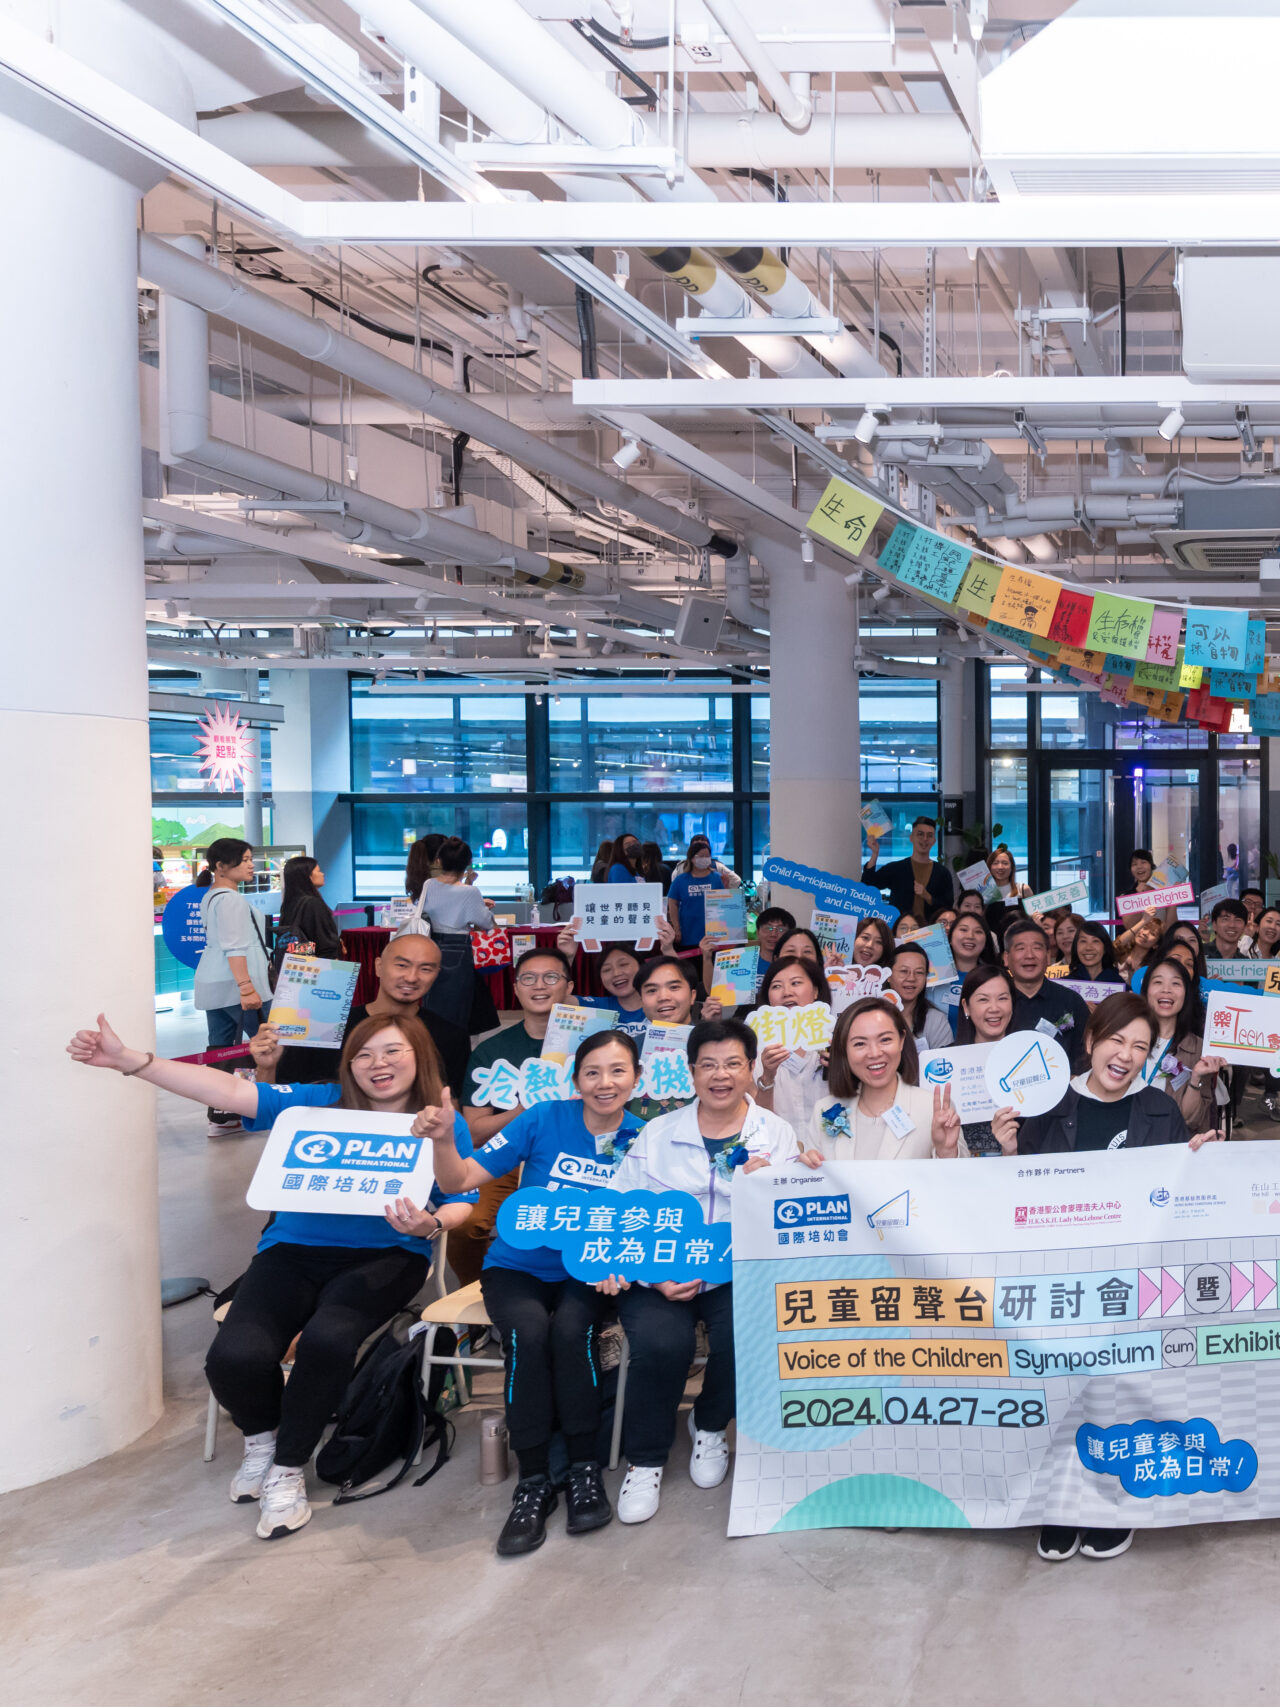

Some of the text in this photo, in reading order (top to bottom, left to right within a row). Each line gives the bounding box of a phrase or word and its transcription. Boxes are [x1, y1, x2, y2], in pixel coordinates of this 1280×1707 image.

[819, 492, 867, 542] 生命
[1191, 623, 1231, 641] 可以
[216, 745, 237, 759] 起點
[769, 863, 877, 906] Child Participation Today,
[585, 902, 651, 914] 讓世界聽見
[824, 896, 842, 907] and
[843, 900, 871, 918] Every
[1121, 889, 1190, 913] Child Rights
[585, 915, 651, 926] 兒童的聲音
[345, 962, 361, 997] Children
[1068, 984, 1118, 999] 童為本
[342, 998, 353, 1012] the
[630, 1024, 648, 1034] PLA
[752, 1007, 834, 1048] 街燈
[473, 1053, 692, 1107] 冷熱機
[960, 1066, 985, 1076] 香港基
[344, 1139, 417, 1160] PLAN
[341, 1158, 410, 1168] INTERNATIONAL
[1017, 1167, 1085, 1178] 合作夥伴 Partners
[282, 1173, 404, 1195] 國際培幼會
[773, 1176, 825, 1186] 主辦 Organiser
[806, 1200, 848, 1215] PLAN
[1029, 1200, 1122, 1215] 香港聖公會麥理浩夫人中心
[515, 1204, 684, 1233] 讓兒童參與
[1028, 1216, 1059, 1225] H.K.S.K.H.
[1059, 1216, 1072, 1224] Lady
[778, 1228, 849, 1245] 國際培幼會
[579, 1236, 733, 1265] 成為日常！
[783, 1285, 989, 1327] 兒童留聲台
[999, 1276, 1135, 1321] 研討會
[1195, 1275, 1221, 1303] 暨
[784, 1350, 841, 1371] Voice
[847, 1347, 869, 1369] of
[873, 1347, 906, 1369] the
[911, 1347, 1003, 1370] Children
[1014, 1341, 1156, 1377] Symposium
[1164, 1339, 1195, 1355] cum
[782, 1396, 1047, 1428] 2024.04.27-28
[1087, 1432, 1208, 1462] 讓兒童參與
[1133, 1456, 1245, 1483] 成為日常！
